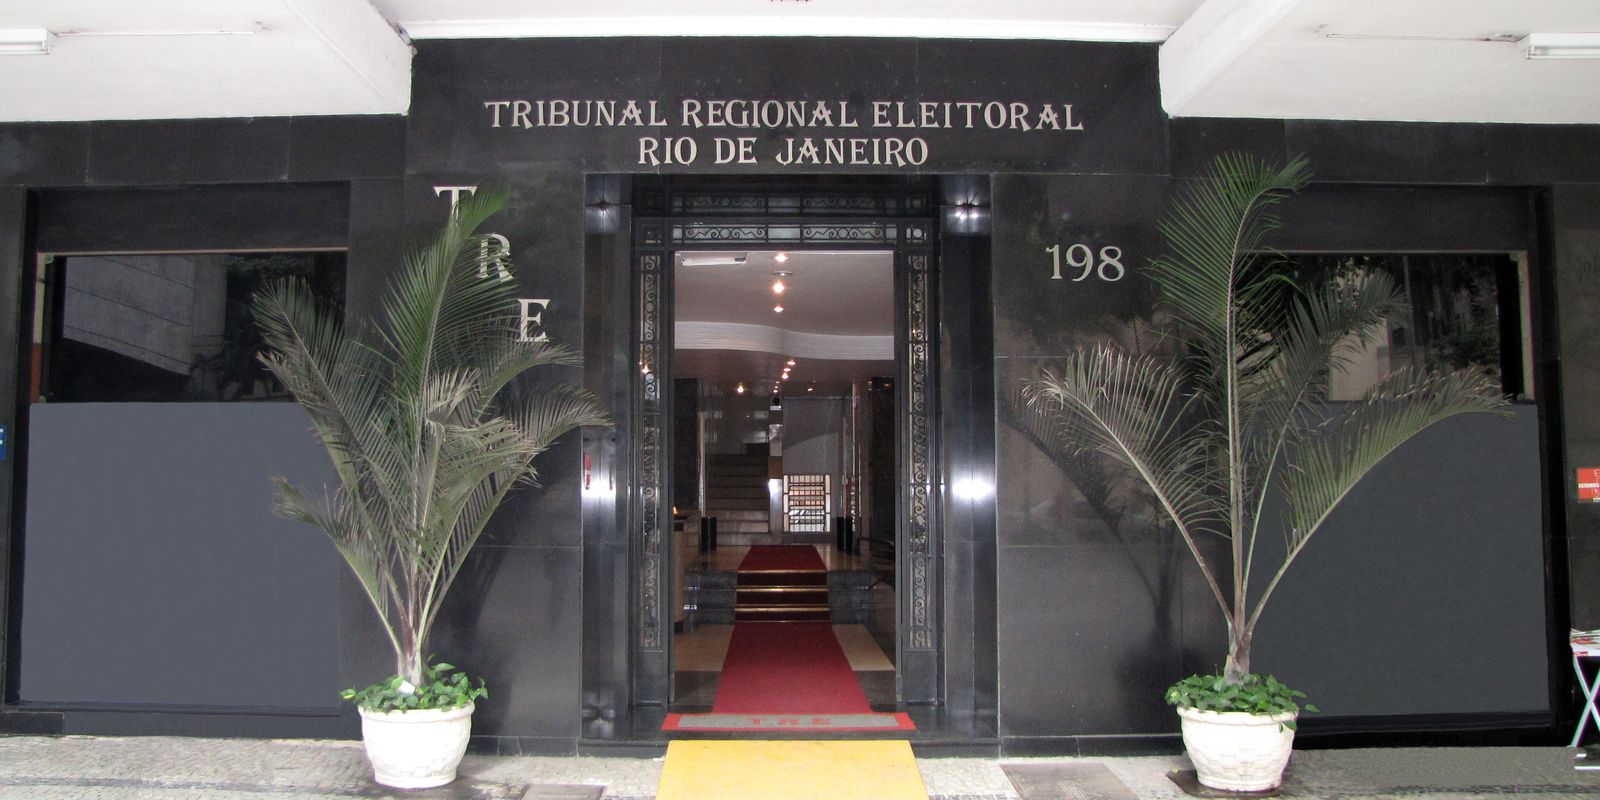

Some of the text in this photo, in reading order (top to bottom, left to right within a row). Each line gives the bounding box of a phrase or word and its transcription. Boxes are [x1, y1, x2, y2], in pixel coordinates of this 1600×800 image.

[484, 98, 1084, 132] TRIBUNAL REGIONAL ELEITORAL
[637, 137, 930, 167] RIO DE JANEIRO
[1045, 244, 1126, 282] 198
